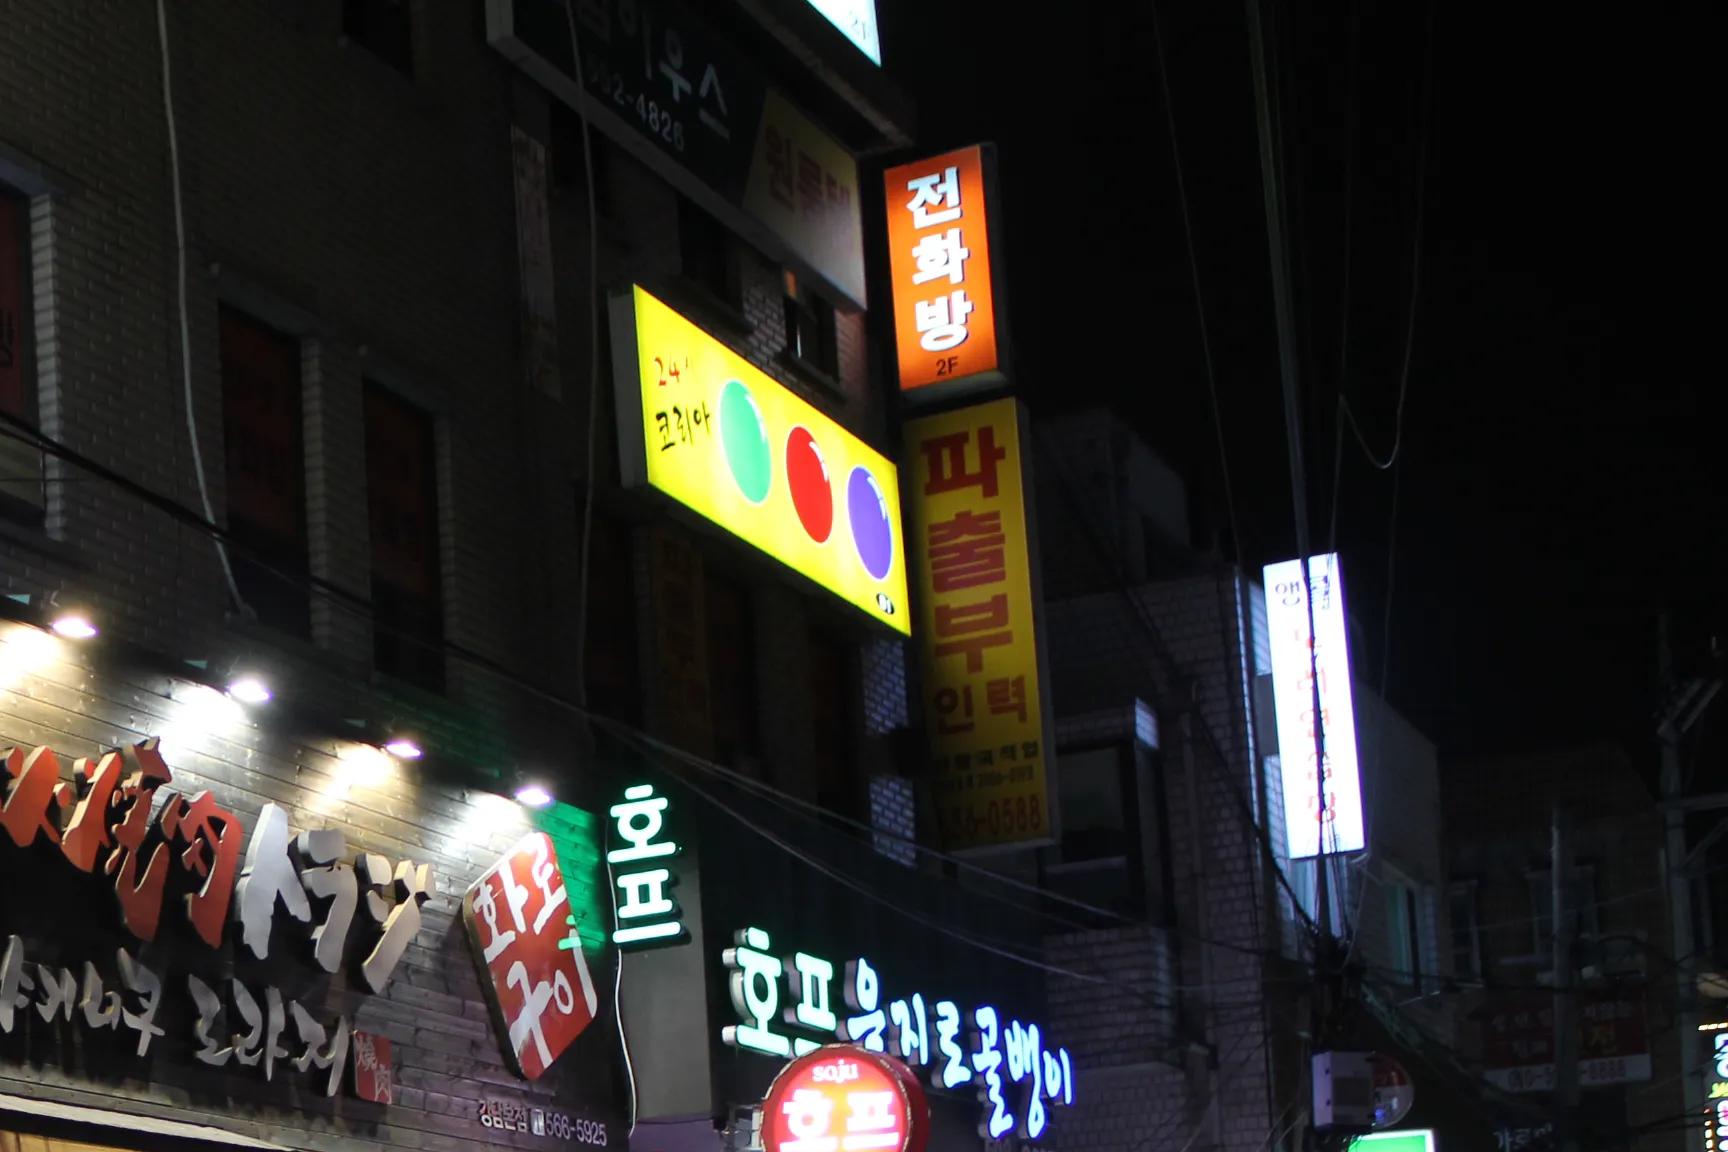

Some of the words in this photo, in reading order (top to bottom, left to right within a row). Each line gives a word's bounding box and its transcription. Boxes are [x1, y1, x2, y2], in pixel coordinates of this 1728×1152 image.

[906, 167, 973, 352] 전화방
[935, 356, 959, 377] 2F
[655, 401, 711, 453] 코리아
[919, 425, 1013, 676] 파출부
[933, 675, 1028, 737] 인력
[473, 850, 570, 963] 화로
[607, 784, 682, 943] 호프
[727, 926, 837, 1057] 호프
[845, 957, 1073, 1139] 을지로골뱅이
[812, 1058, 860, 1083] soju
[478, 1100, 529, 1134] 강남본점
[545, 1111, 609, 1148] 566-5925
